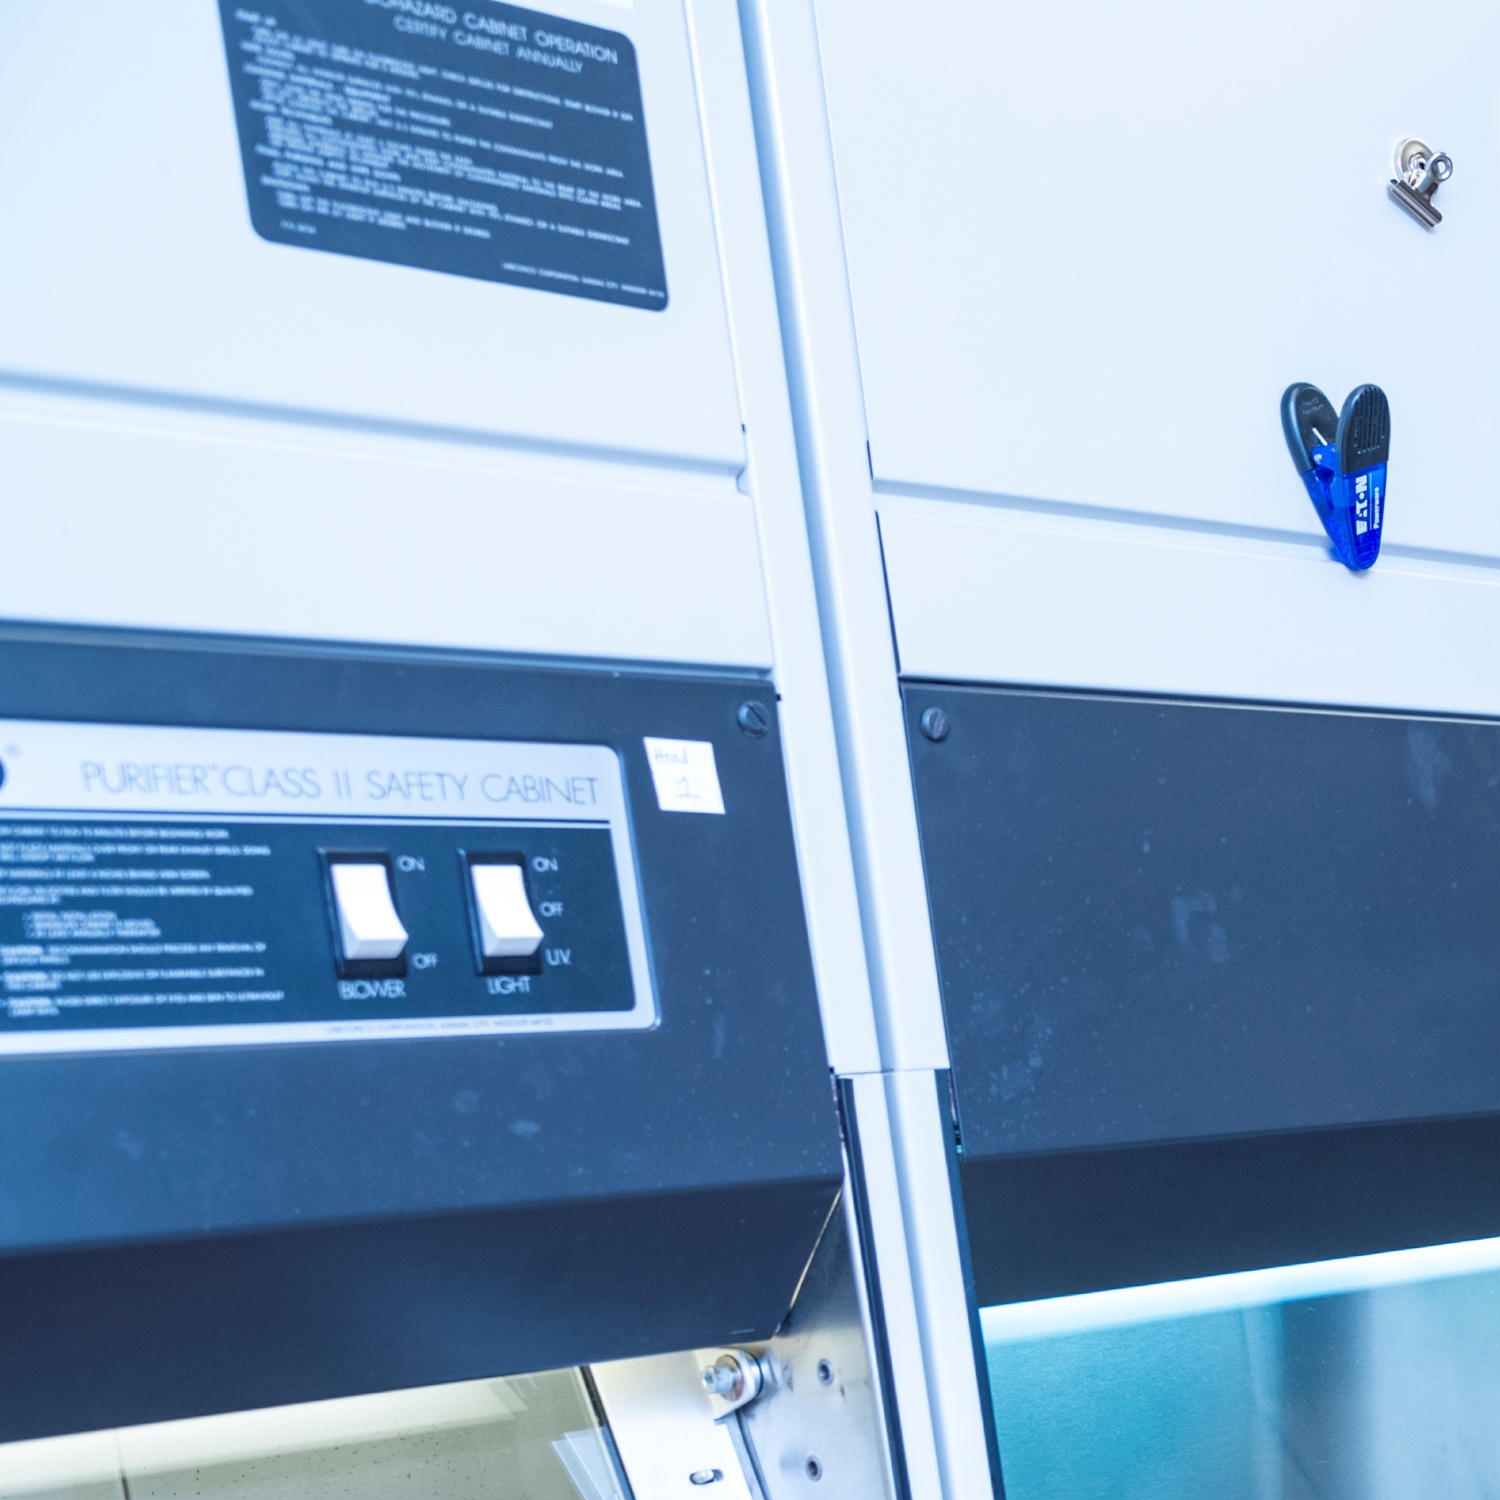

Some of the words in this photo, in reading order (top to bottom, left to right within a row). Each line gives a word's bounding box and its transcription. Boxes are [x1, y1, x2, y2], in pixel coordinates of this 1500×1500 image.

[392, 14, 448, 40] CERTIFY
[452, 29, 510, 57] CABINET
[515, 45, 583, 73] ANNUALLY
[462, 12, 528, 42] CABINET
[533, 30, 618, 64] OPERATION
[654, 746, 689, 766] Hood
[80, 759, 210, 796] PURIFIER
[219, 764, 323, 799] CLASS
[333, 770, 353, 799] II
[366, 770, 469, 802] SAFETY
[481, 774, 600, 805] CABINET
[674, 776, 702, 799] 1
[398, 855, 426, 872] ON
[532, 855, 560, 873] ON
[538, 901, 565, 917] OFF
[412, 952, 440, 969] OFF
[337, 979, 407, 1001] BLOWER
[486, 977, 531, 995] LIGHT
